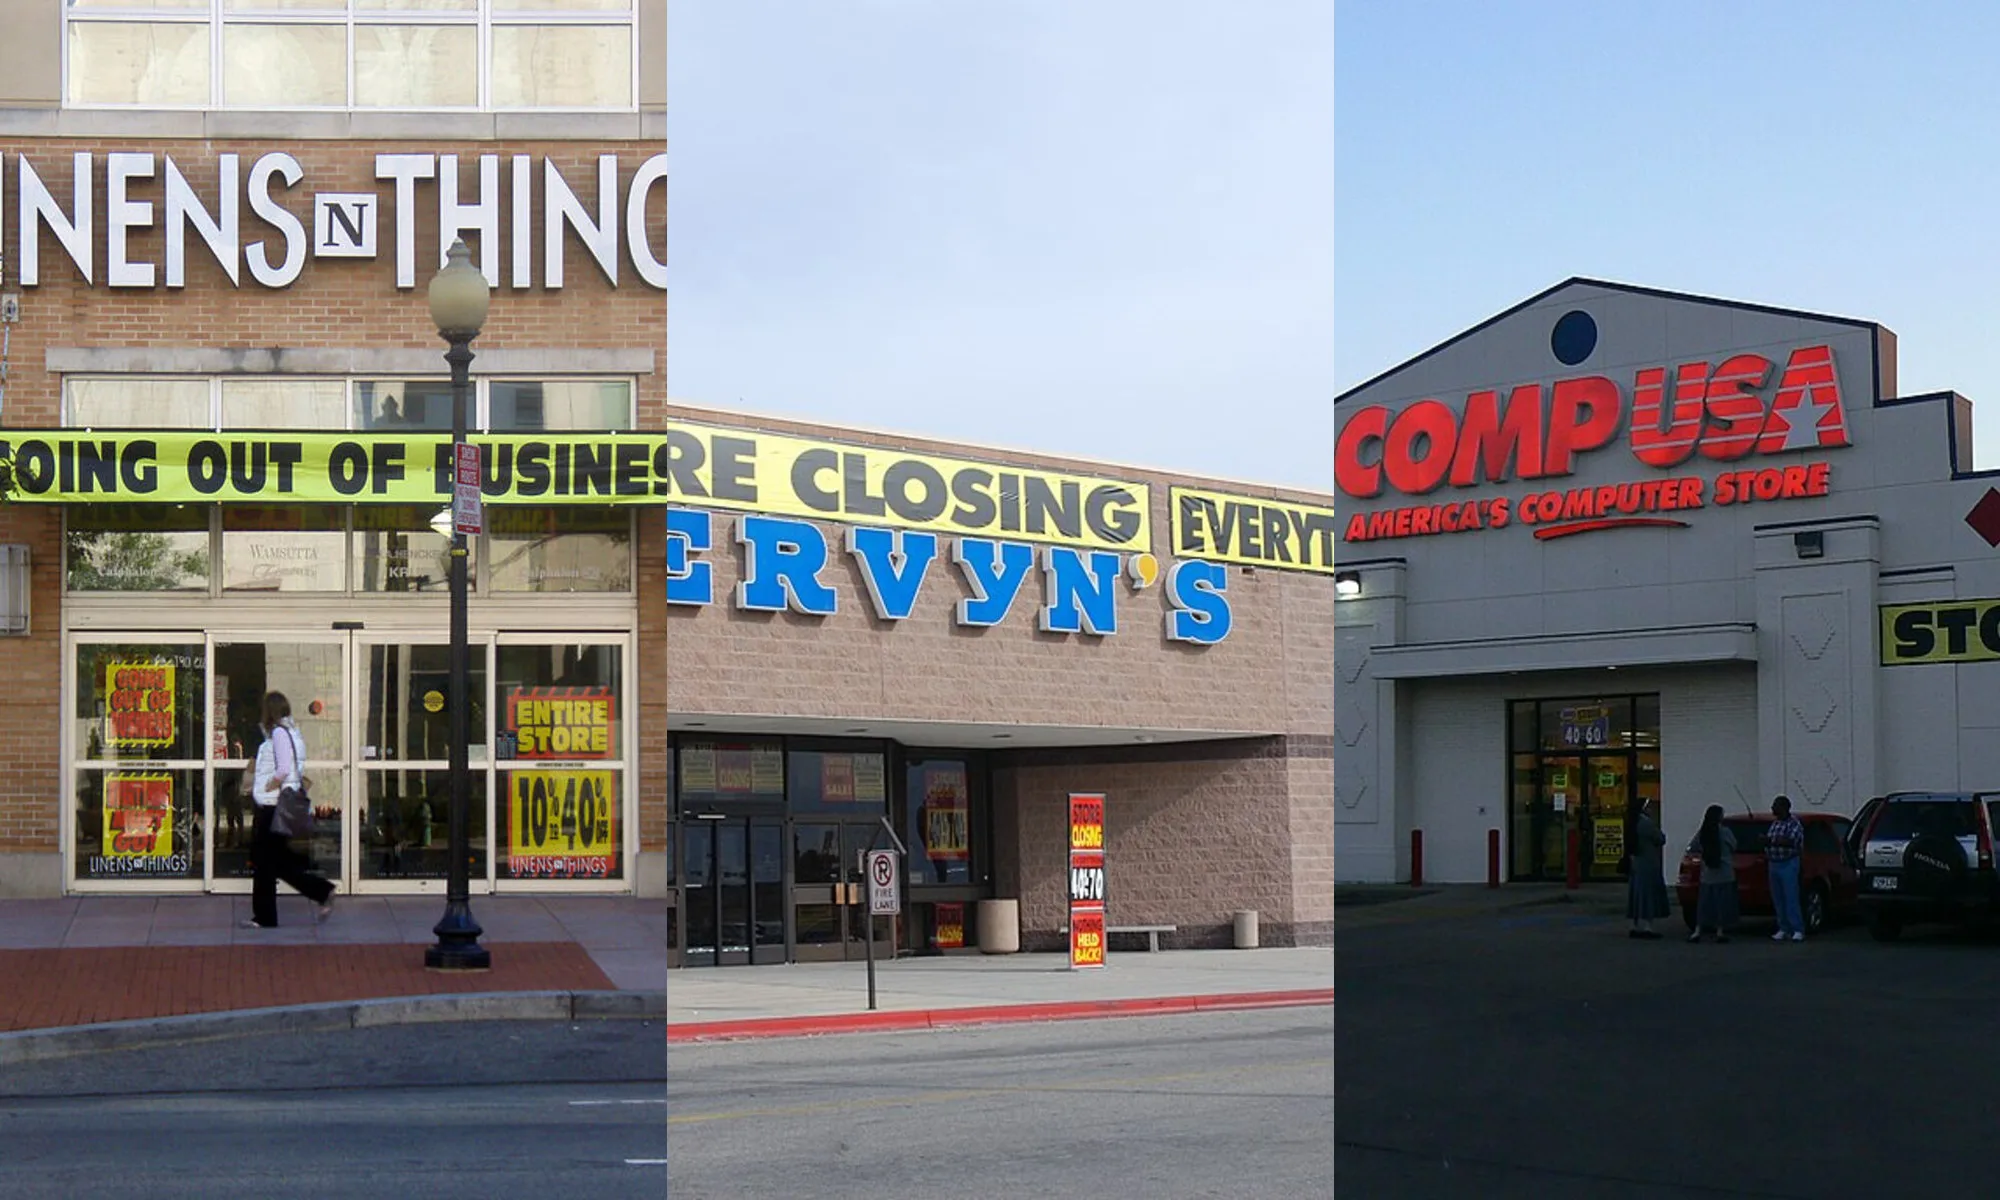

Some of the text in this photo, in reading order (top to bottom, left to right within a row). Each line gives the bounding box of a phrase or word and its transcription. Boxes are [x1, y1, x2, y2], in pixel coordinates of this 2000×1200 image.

[0, 151, 306, 287] NENS
[323, 203, 367, 247] N
[187, 440, 302, 494] OUT
[328, 441, 406, 495] OF
[790, 447, 1142, 543] CLOSING
[1345, 462, 1831, 542] AMERICA'S COMPUTER STORE
[114, 668, 167, 689] GOING
[110, 690, 171, 711] OUT OF
[517, 699, 608, 726] ENTIRE
[517, 726, 608, 754] STORE
[519, 777, 559, 848] 10%
[561, 777, 606, 850] 40%
[1073, 803, 1101, 825] STORE
[90, 856, 133, 872] LINENS
[143, 855, 188, 872] THINGS
[511, 856, 553, 873] LINENS
[563, 856, 607, 873] THINGS
[875, 888, 893, 898] FIRE
[875, 900, 895, 910] LANE
[1078, 932, 1101, 947] HELD
